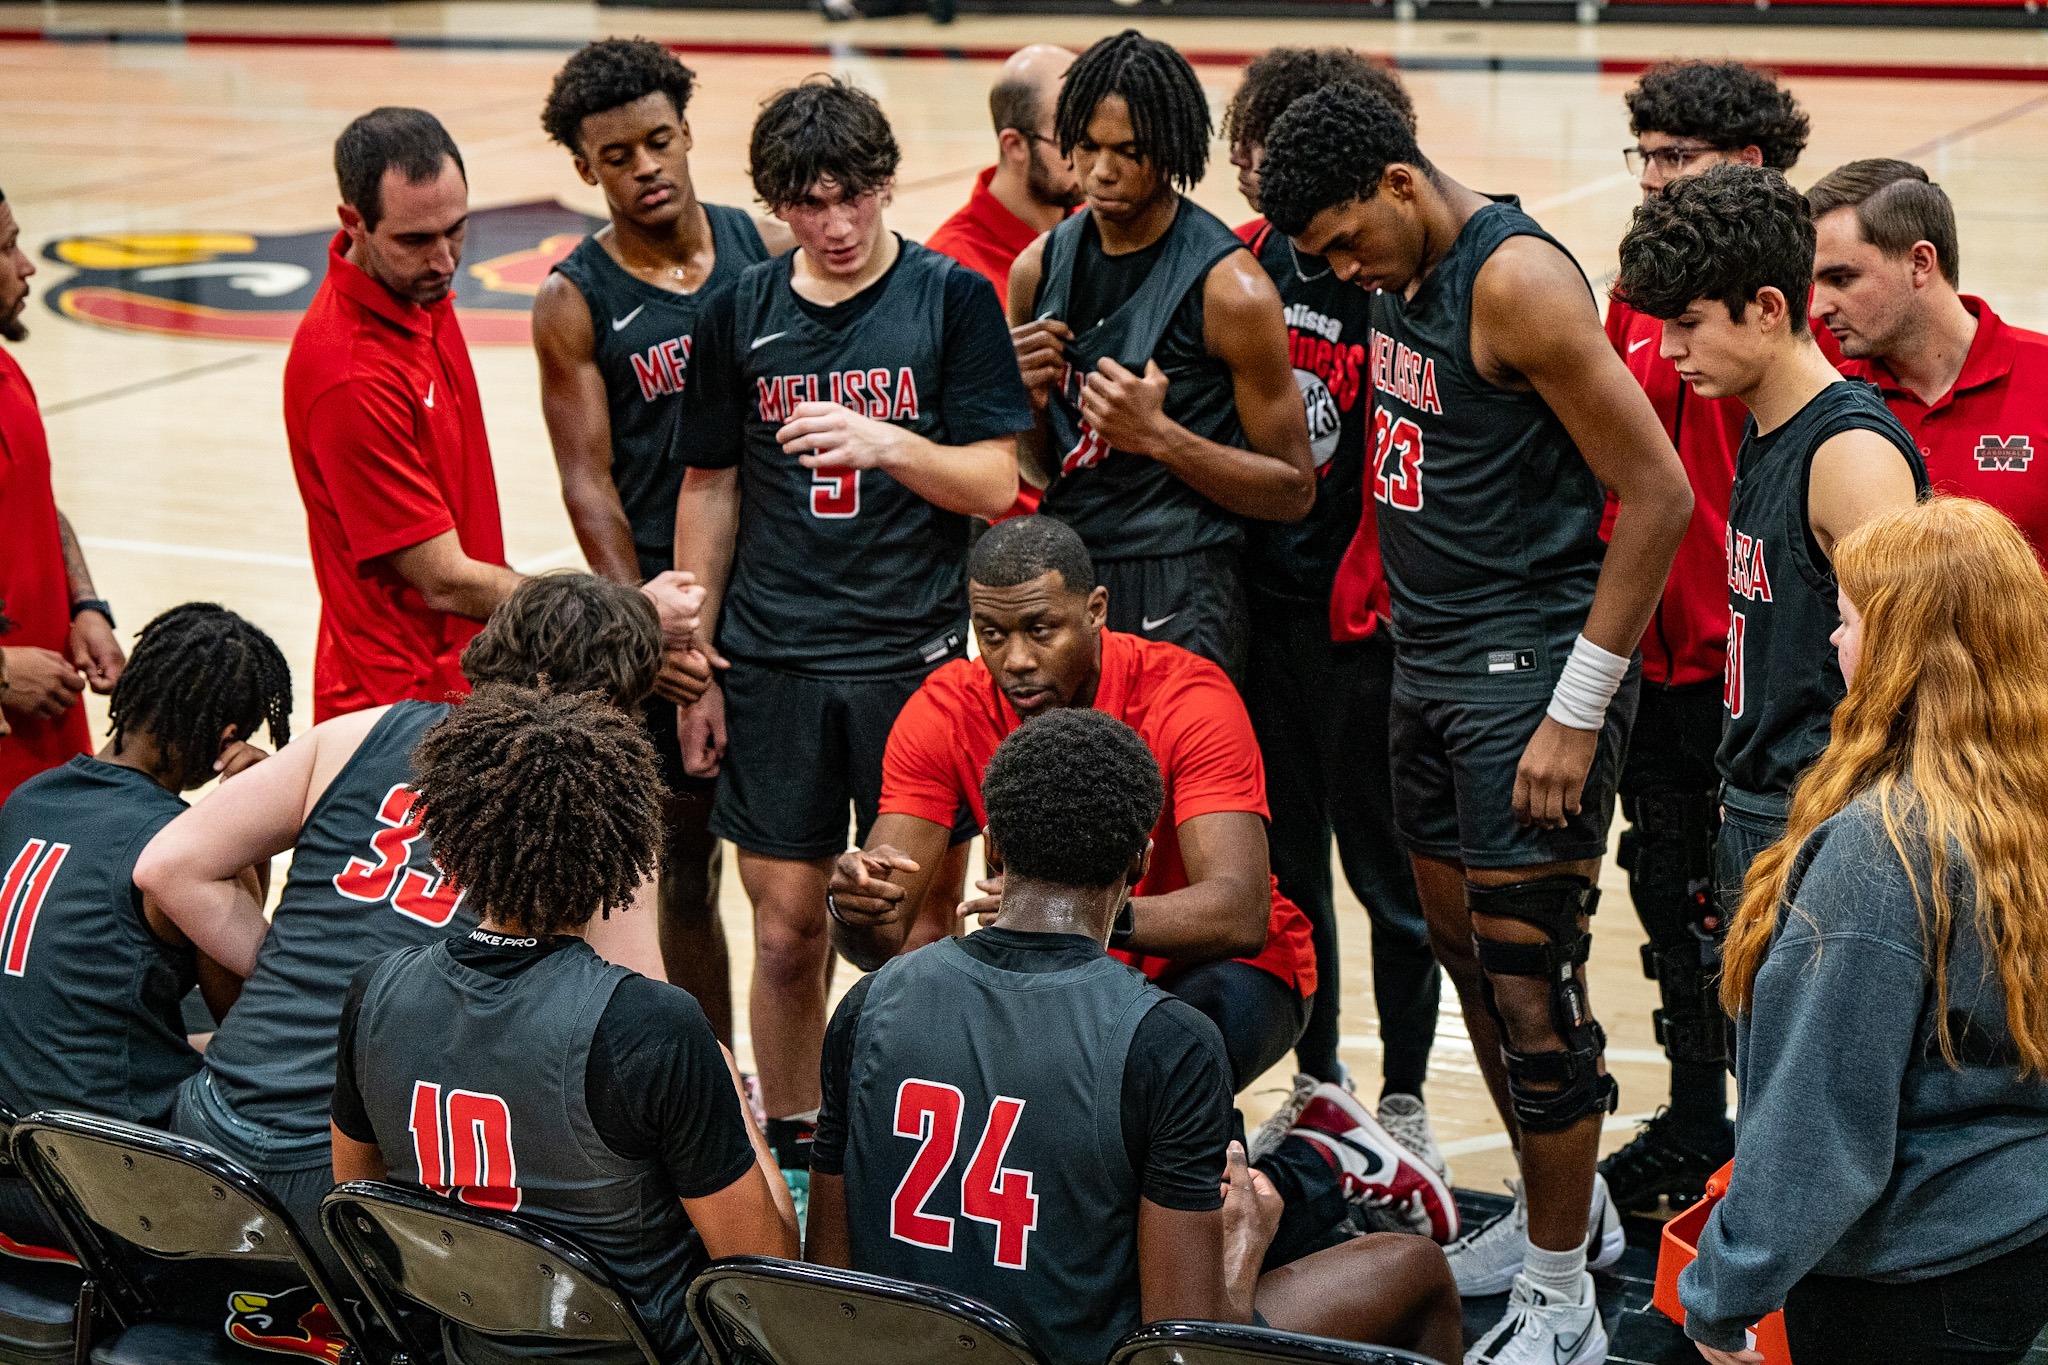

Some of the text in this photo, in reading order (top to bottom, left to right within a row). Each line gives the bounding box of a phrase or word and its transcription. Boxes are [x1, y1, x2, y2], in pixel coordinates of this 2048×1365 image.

[757, 367, 920, 422] MELISSA
[1371, 327, 1443, 415] MELISSA
[810, 447, 862, 519] 5
[1373, 404, 1424, 512] 23
[1974, 435, 2034, 471] M
[1521, 655, 1530, 667] L
[0, 837, 71, 978] 11
[468, 930, 538, 948] NIKE PRO
[408, 1079, 523, 1212] 10
[889, 1077, 1040, 1271] 24
